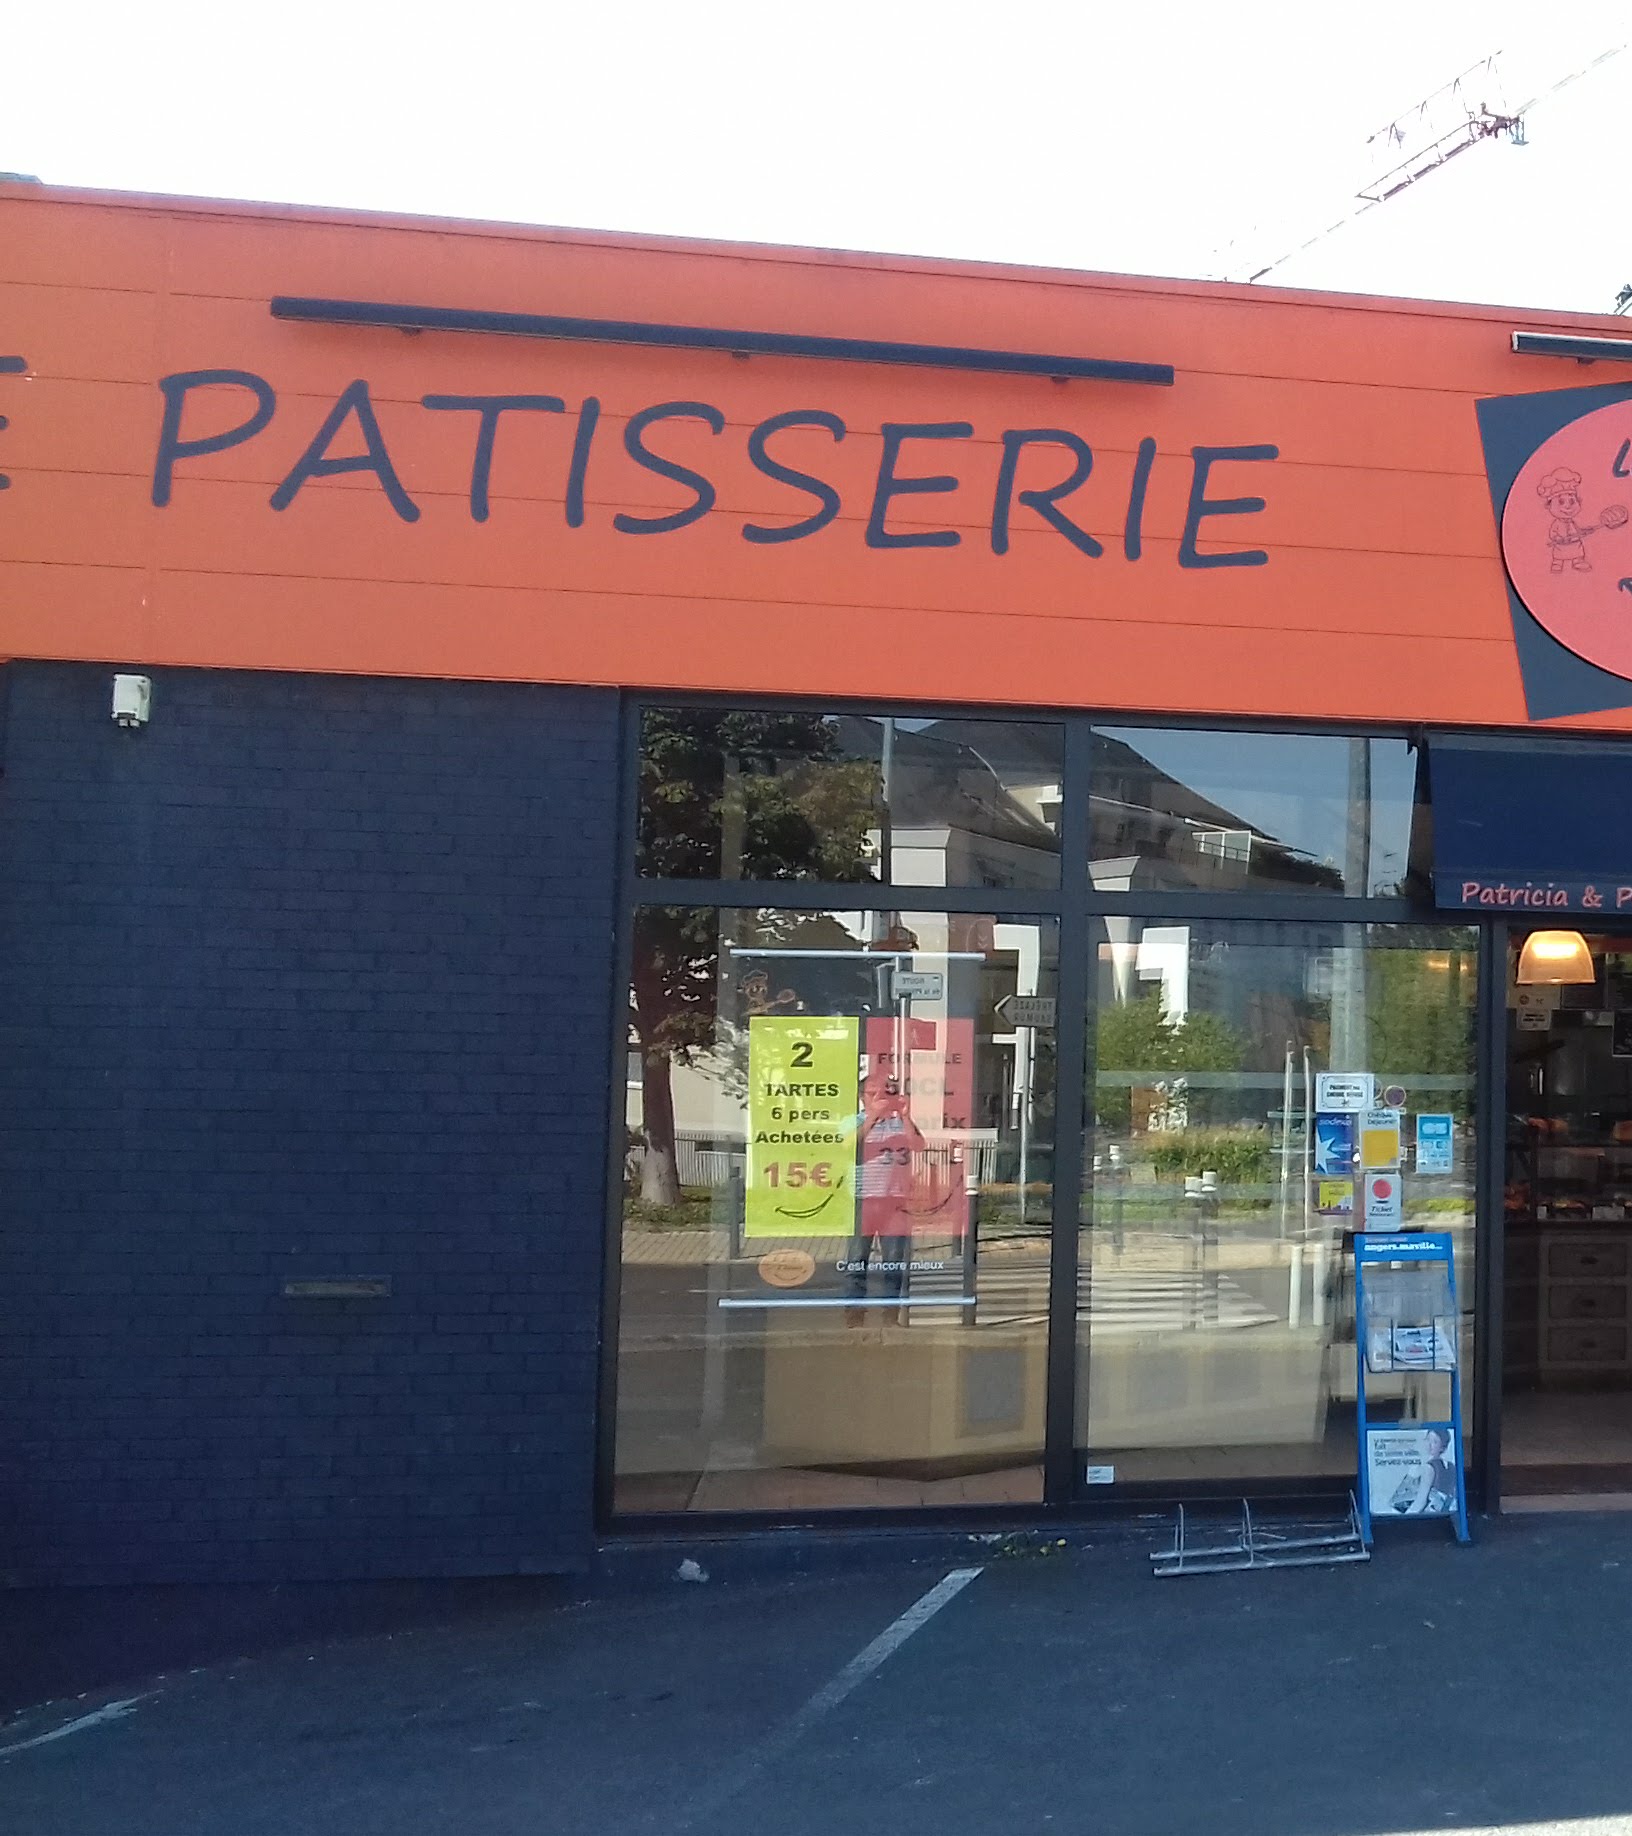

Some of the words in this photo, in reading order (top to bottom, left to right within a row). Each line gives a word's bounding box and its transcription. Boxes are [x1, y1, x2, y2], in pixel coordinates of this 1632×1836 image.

[151, 368, 1280, 570] PATISSERIE
[1461, 881, 1569, 908] Patricia
[1581, 886, 1603, 908] &
[790, 1041, 814, 1068] 2
[765, 1083, 839, 1097] TARTES
[771, 1107, 783, 1120] 6
[788, 1109, 830, 1122] pers
[755, 1131, 844, 1144] Achetées
[763, 1161, 833, 1188] 15€
[835, 1260, 864, 1272] C'est
[867, 1261, 906, 1272] encore
[909, 1260, 944, 1270] mieux
